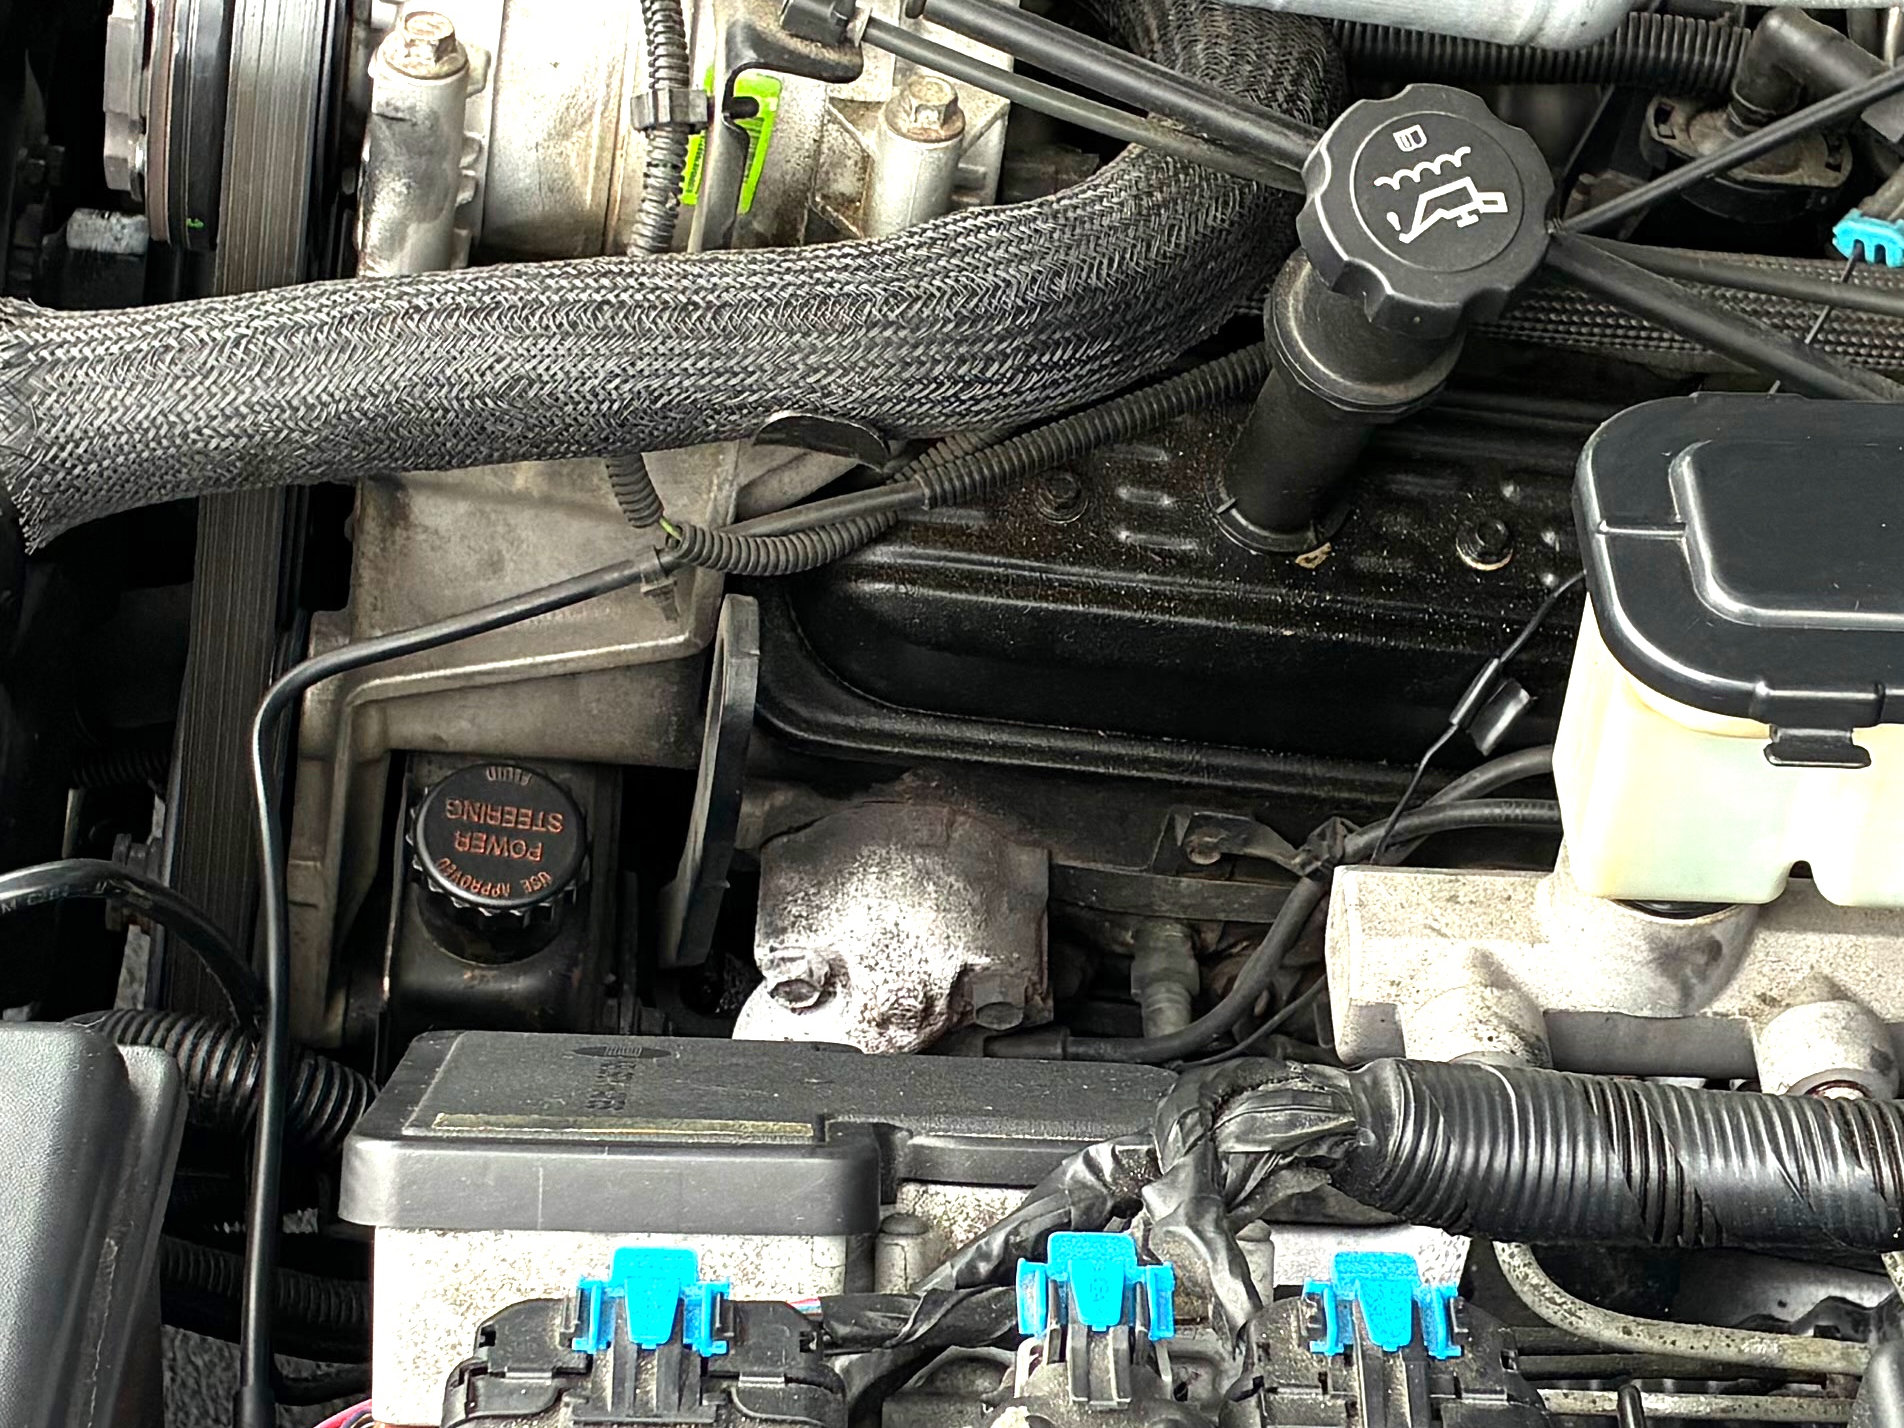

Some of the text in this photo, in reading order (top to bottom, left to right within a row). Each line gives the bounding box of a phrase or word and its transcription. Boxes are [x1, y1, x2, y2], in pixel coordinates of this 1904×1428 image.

[445, 797, 564, 834] STEERING
[453, 829, 544, 863] POWER
[435, 857, 553, 899] USE APPROVED
